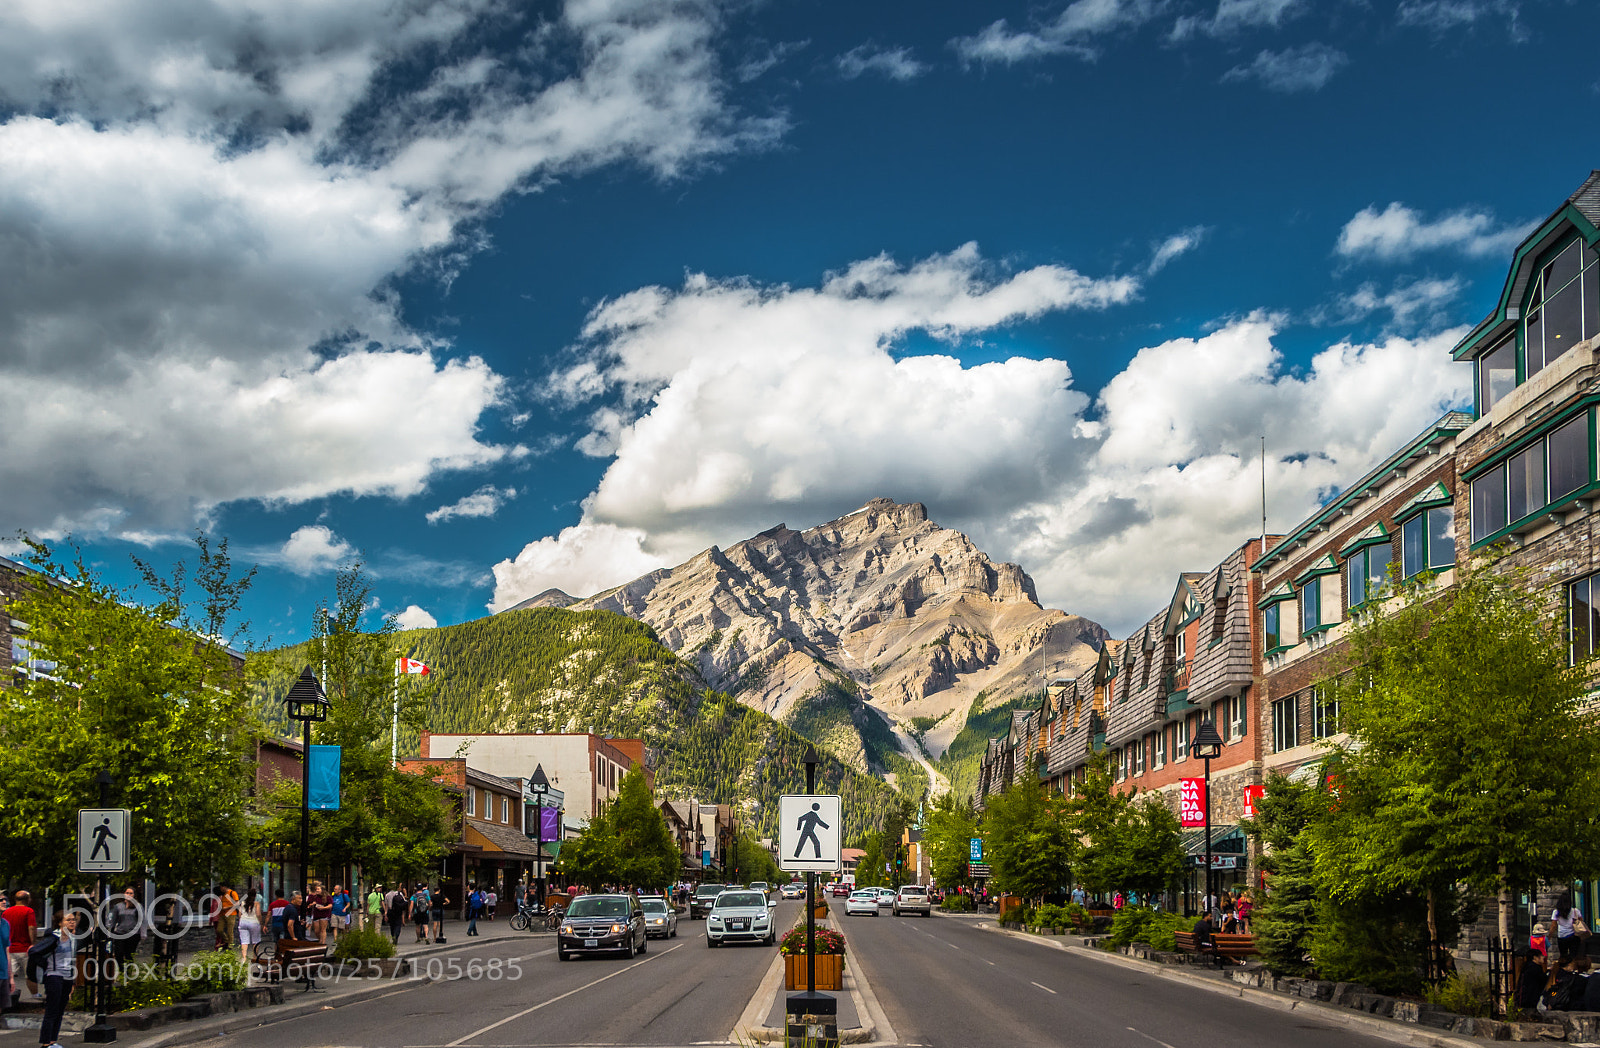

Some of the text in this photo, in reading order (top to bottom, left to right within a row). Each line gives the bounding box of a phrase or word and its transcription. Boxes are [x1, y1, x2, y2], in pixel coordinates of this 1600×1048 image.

[1182, 781, 1198, 790] CA
[1182, 791, 1199, 800] NA
[1182, 801, 1199, 810] DA
[1182, 811, 1204, 820] 150
